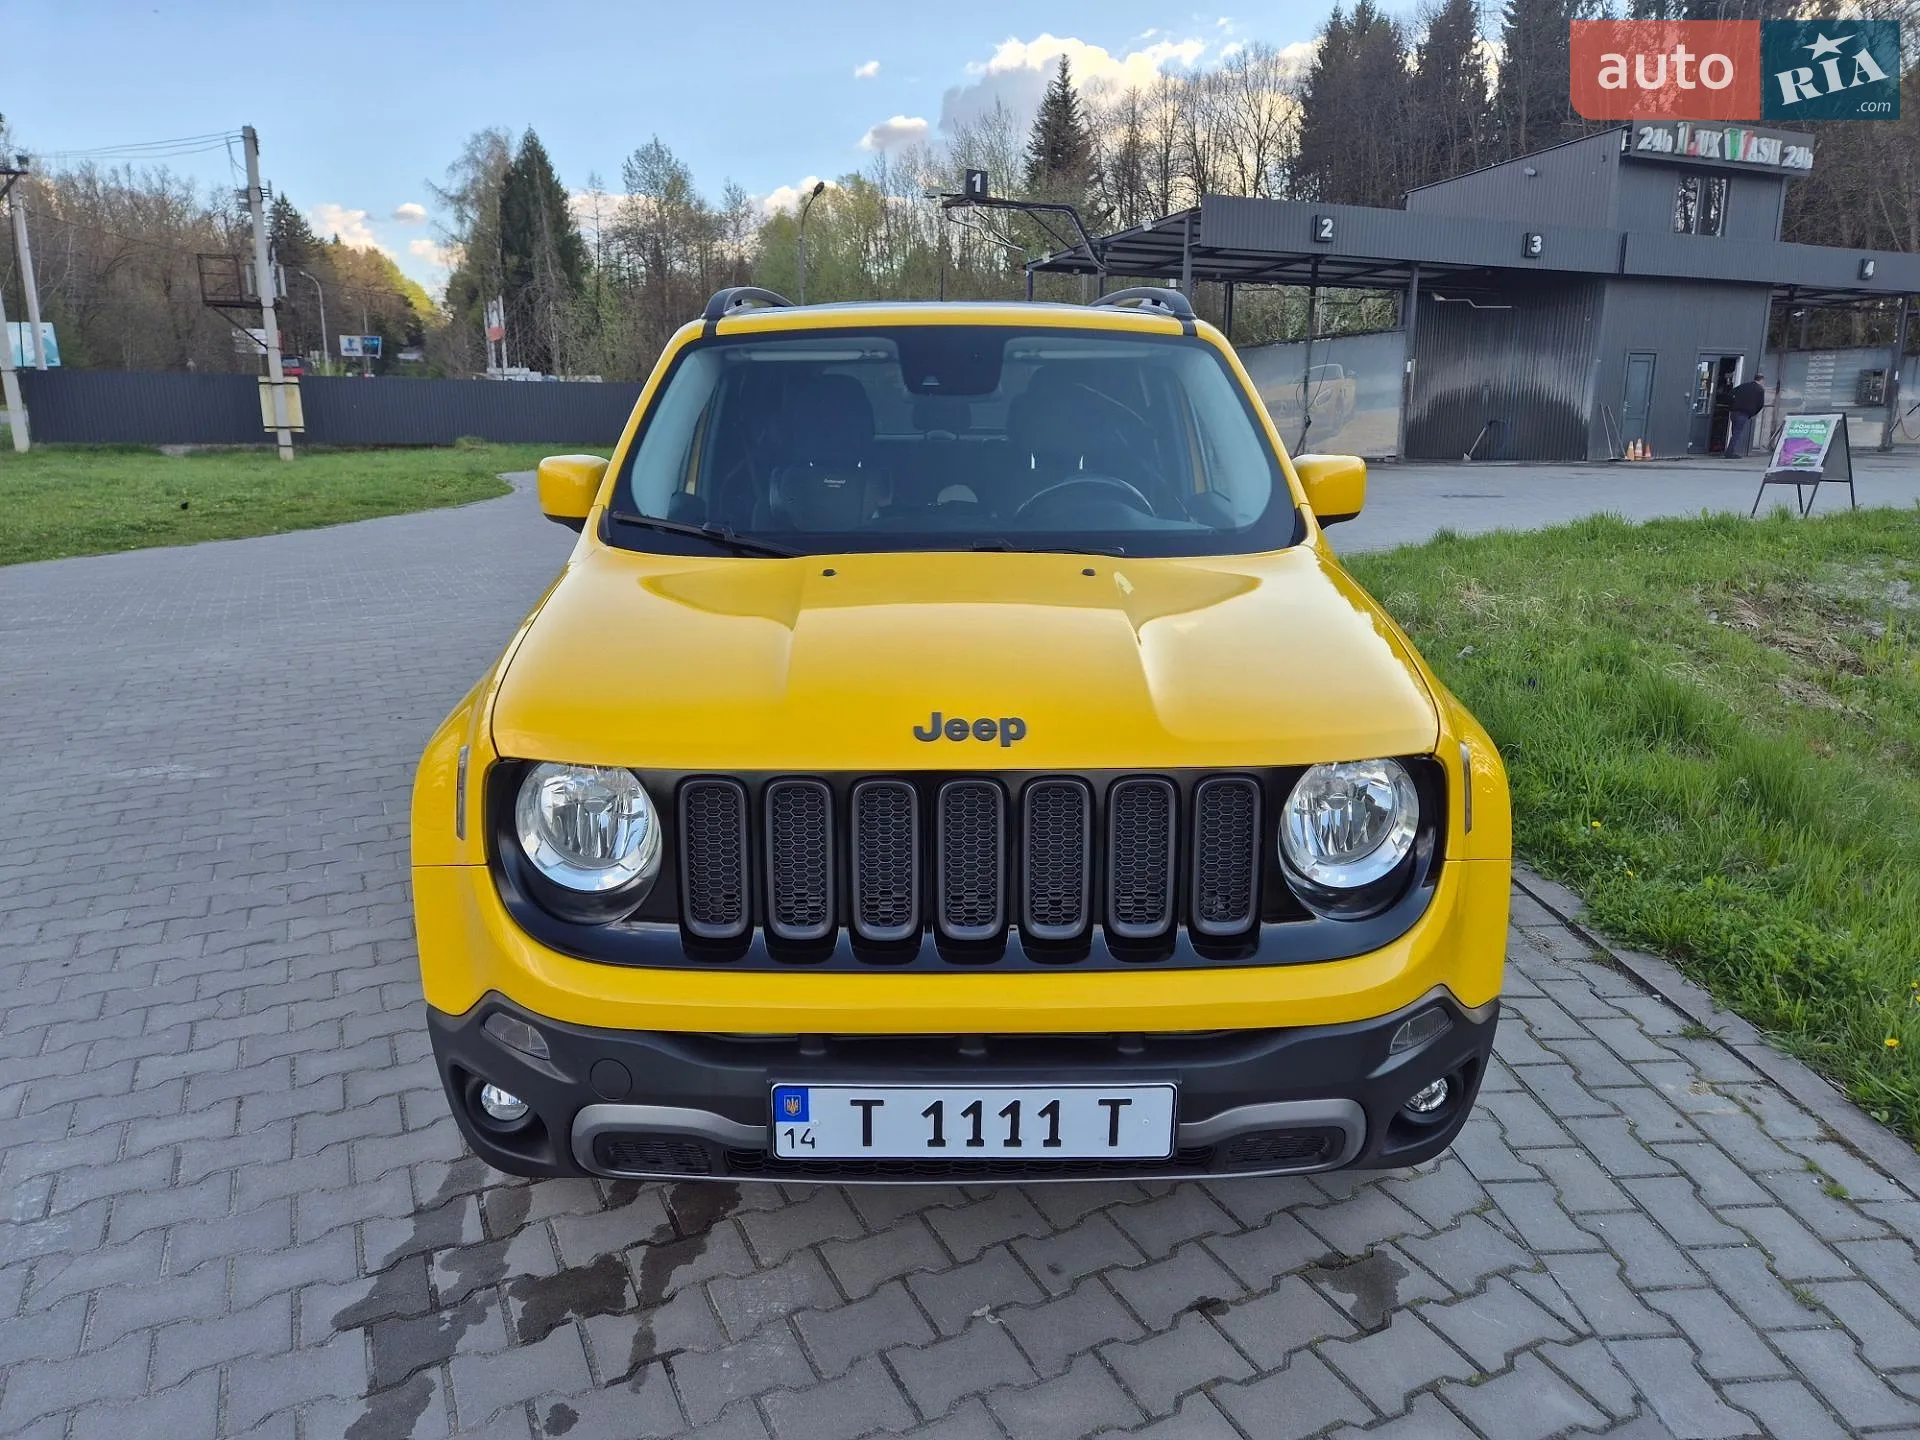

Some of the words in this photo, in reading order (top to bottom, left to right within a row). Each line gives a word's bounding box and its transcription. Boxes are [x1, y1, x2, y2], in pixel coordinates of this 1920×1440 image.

[1723, 127, 1782, 165] WASH
[972, 173, 981, 193] 1
[1320, 218, 1333, 238] 2
[1530, 235, 1542, 253] 3
[1864, 261, 1875, 276] 4
[912, 711, 1027, 748] Jeep
[849, 1099, 886, 1148] T
[920, 1099, 1063, 1148] 1111
[1097, 1097, 1133, 1148] T
[783, 1127, 816, 1150] 14
